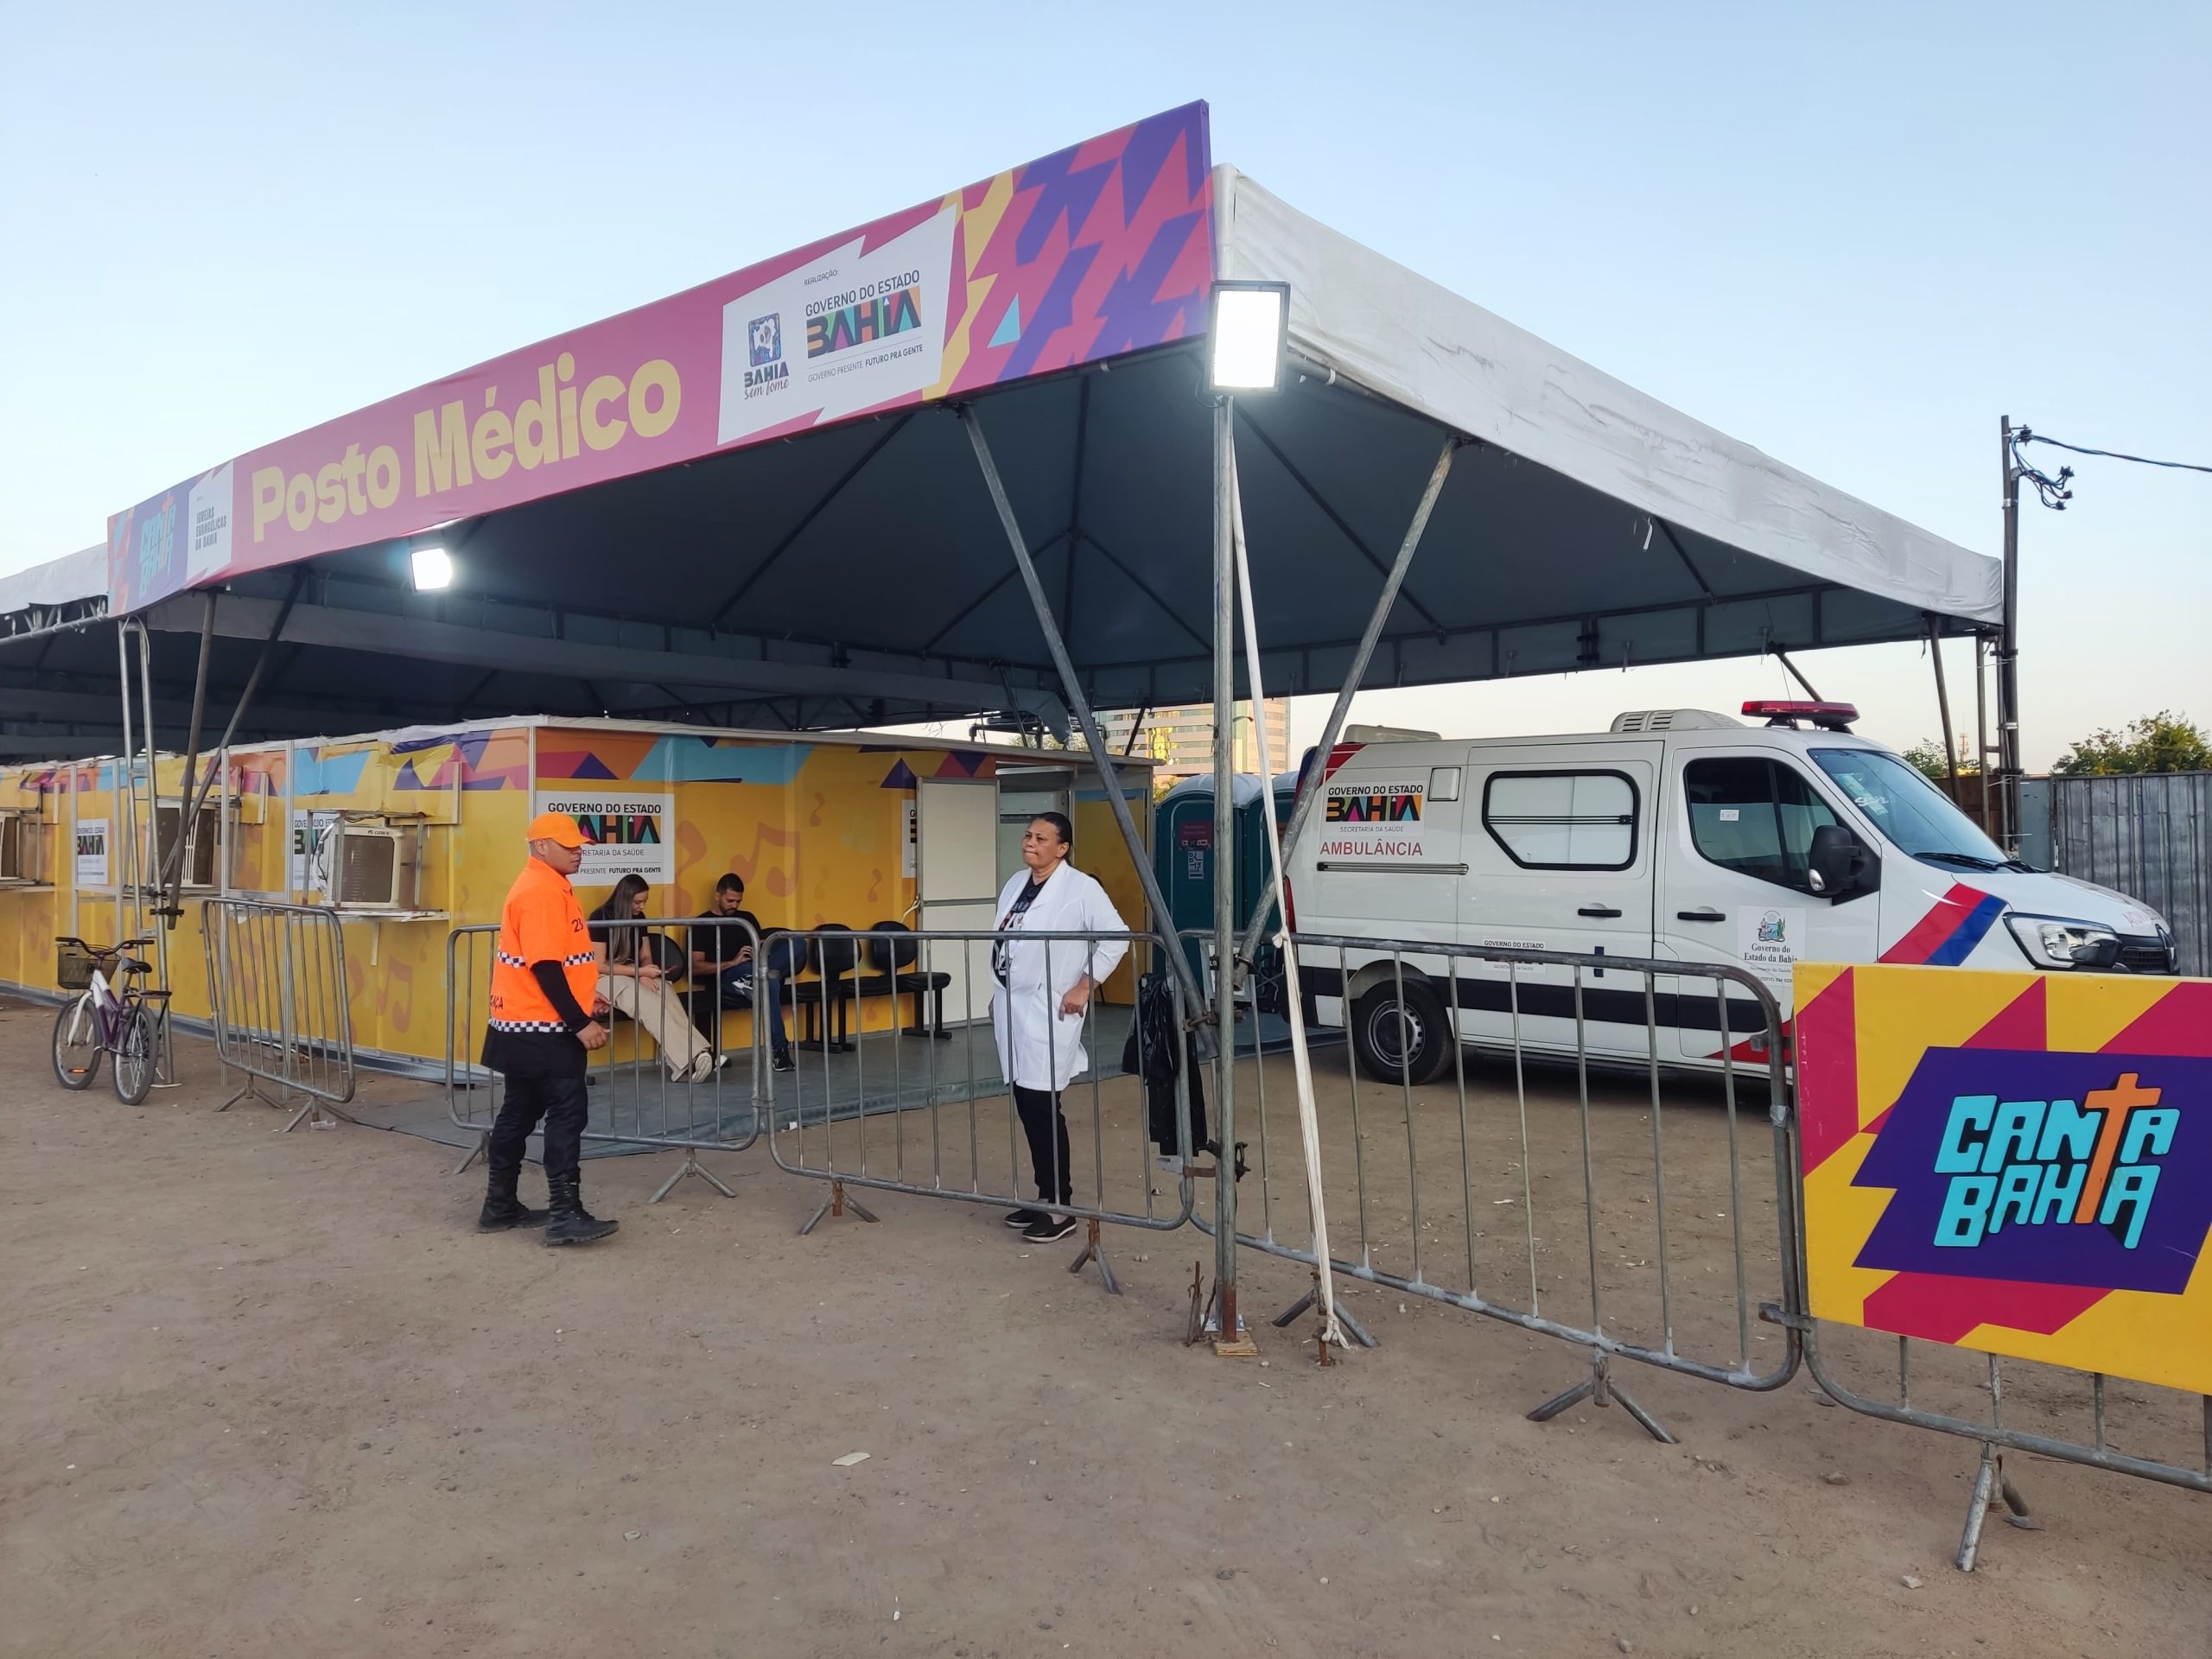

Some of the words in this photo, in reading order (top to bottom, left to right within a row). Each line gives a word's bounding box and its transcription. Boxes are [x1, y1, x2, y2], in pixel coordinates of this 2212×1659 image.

[805, 290, 856, 317] GOVERNO
[860, 284, 874, 300] DO
[878, 270, 919, 294] ESTADO
[806, 286, 922, 359] BAHIA
[744, 361, 789, 388] BAHIA
[808, 368, 836, 383] GOVERNO
[837, 360, 863, 374] PRESENTE
[865, 353, 889, 367] FUTURO
[890, 351, 902, 361] PRA
[903, 344, 923, 357] GENTE
[744, 386, 764, 400] sem
[766, 378, 790, 396] fome
[251, 442, 401, 543] Posto
[414, 352, 682, 499] Médico
[1328, 786, 1370, 795] GOVERNO
[1389, 785, 1423, 793] ESTADO
[548, 803, 602, 812] GOVERNO
[606, 804, 620, 813] DO
[624, 804, 661, 813] ESTADO
[1325, 795, 1422, 822] BAHIA
[576, 815, 661, 843] AHIA
[1320, 838, 1422, 855] AMBULÂNCIA
[1744, 952, 1766, 962] Estado
[1768, 953, 1777, 963] da
[1751, 943, 1780, 952] Governo
[1782, 944, 1790, 953] do
[1935, 1072, 2181, 1174] CANTA
[1933, 1163, 2162, 1249] BAHIA
